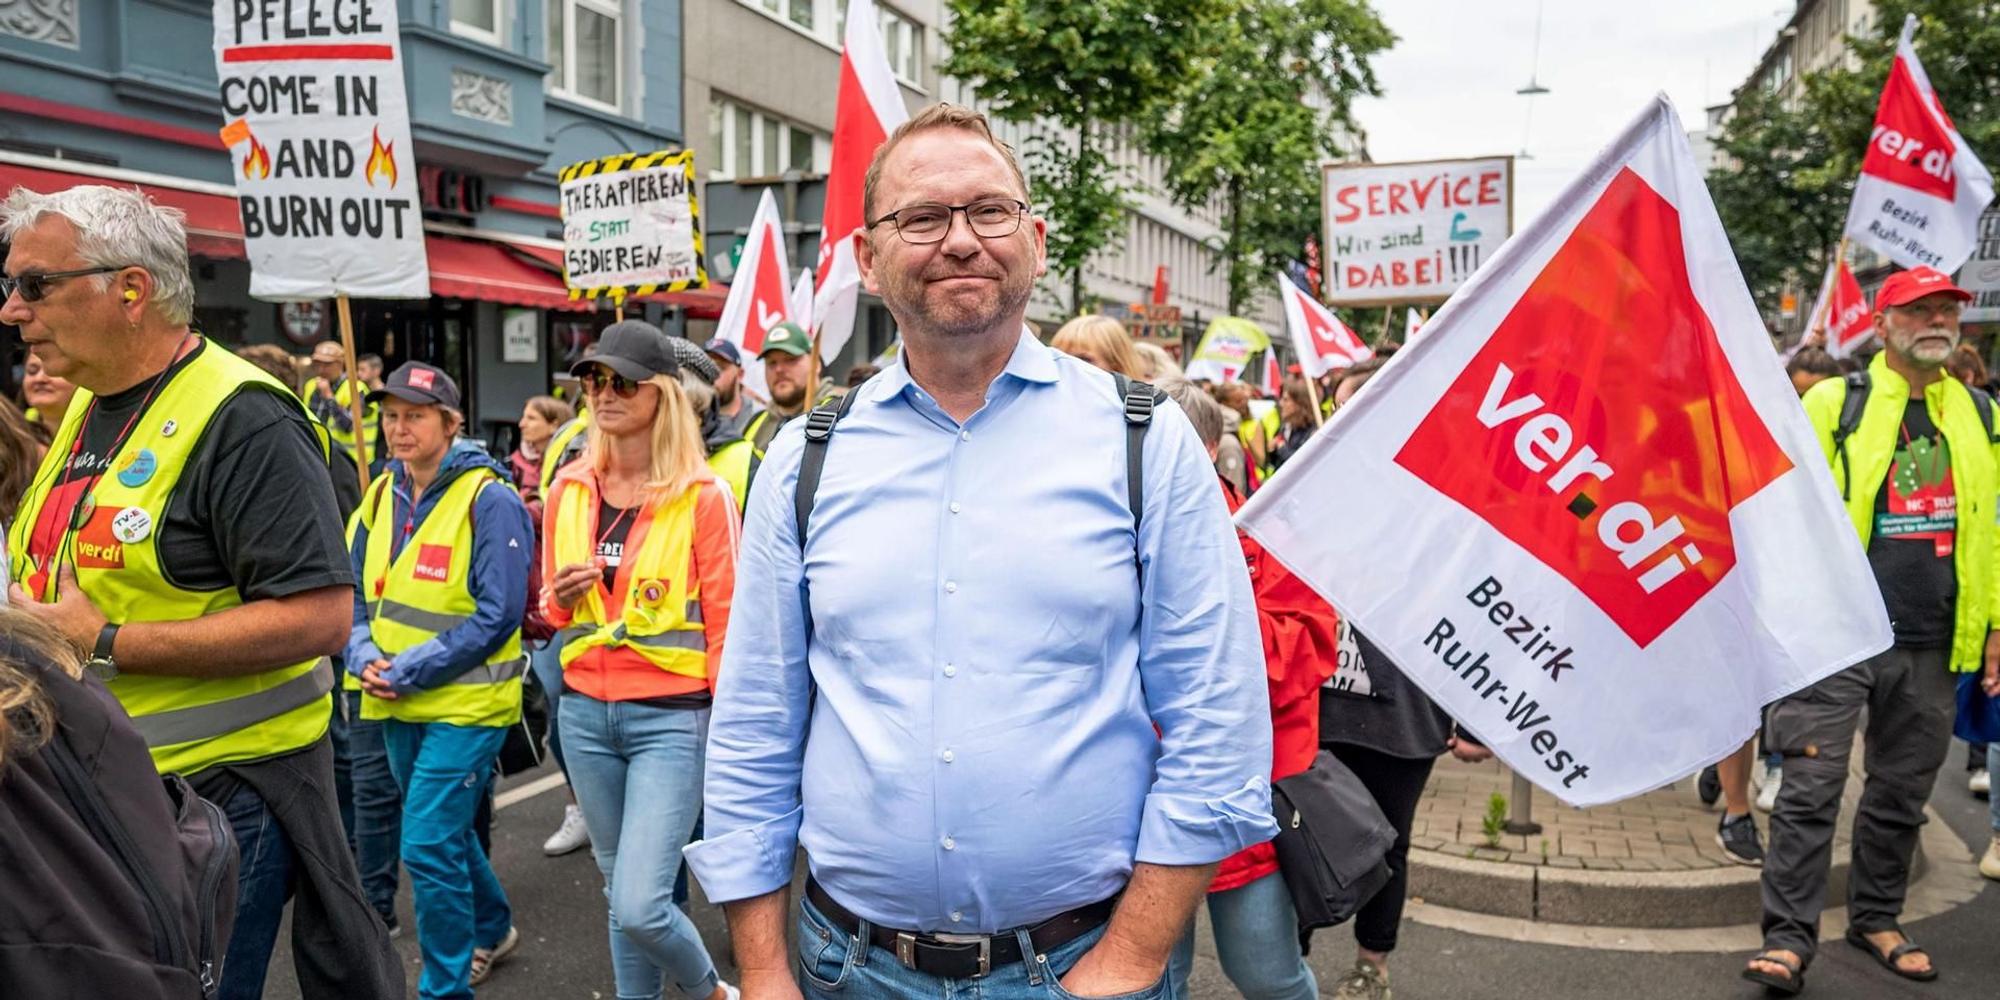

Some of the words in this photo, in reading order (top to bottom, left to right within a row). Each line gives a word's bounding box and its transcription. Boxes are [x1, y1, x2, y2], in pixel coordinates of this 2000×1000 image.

[235, 0, 382, 44] PFLEGE
[221, 76, 319, 115] COME
[336, 76, 378, 116] IN
[275, 139, 354, 178] AND
[565, 172, 685, 215] THERAPIEREN
[589, 220, 630, 242] STATT
[1881, 198, 1929, 231] Bezirk
[1380, 225, 1423, 250] sind
[569, 246, 662, 278] SEDIEREN
[1476, 362, 1703, 595] ver.di
[1466, 576, 1575, 682] Bezirk
[1423, 617, 1591, 789] Ruhr-West
